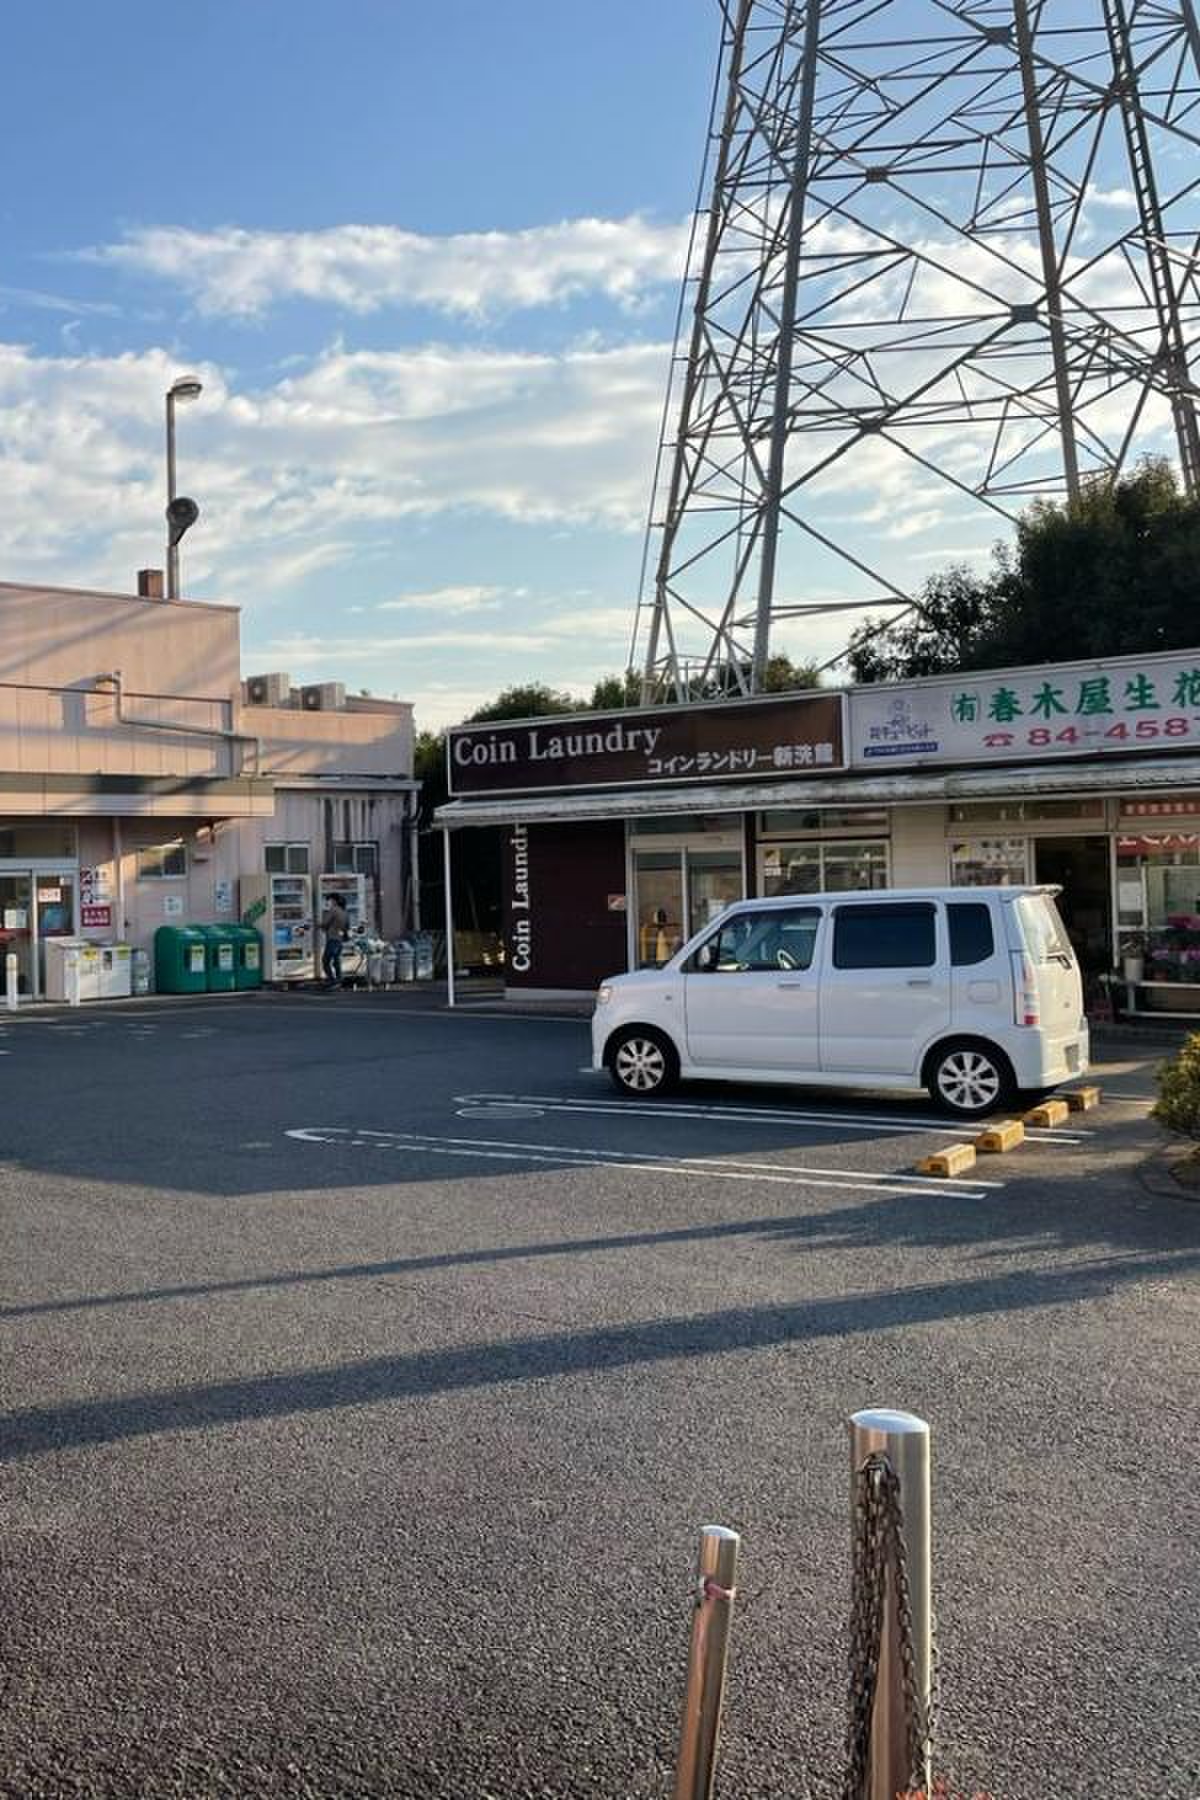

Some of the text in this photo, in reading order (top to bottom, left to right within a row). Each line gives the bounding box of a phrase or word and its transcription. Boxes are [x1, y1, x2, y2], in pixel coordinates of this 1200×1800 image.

[454, 724, 662, 767] Coin Laundry
[1028, 716, 1200, 747] 84-458
[510, 821, 531, 972] Coin Laundr
